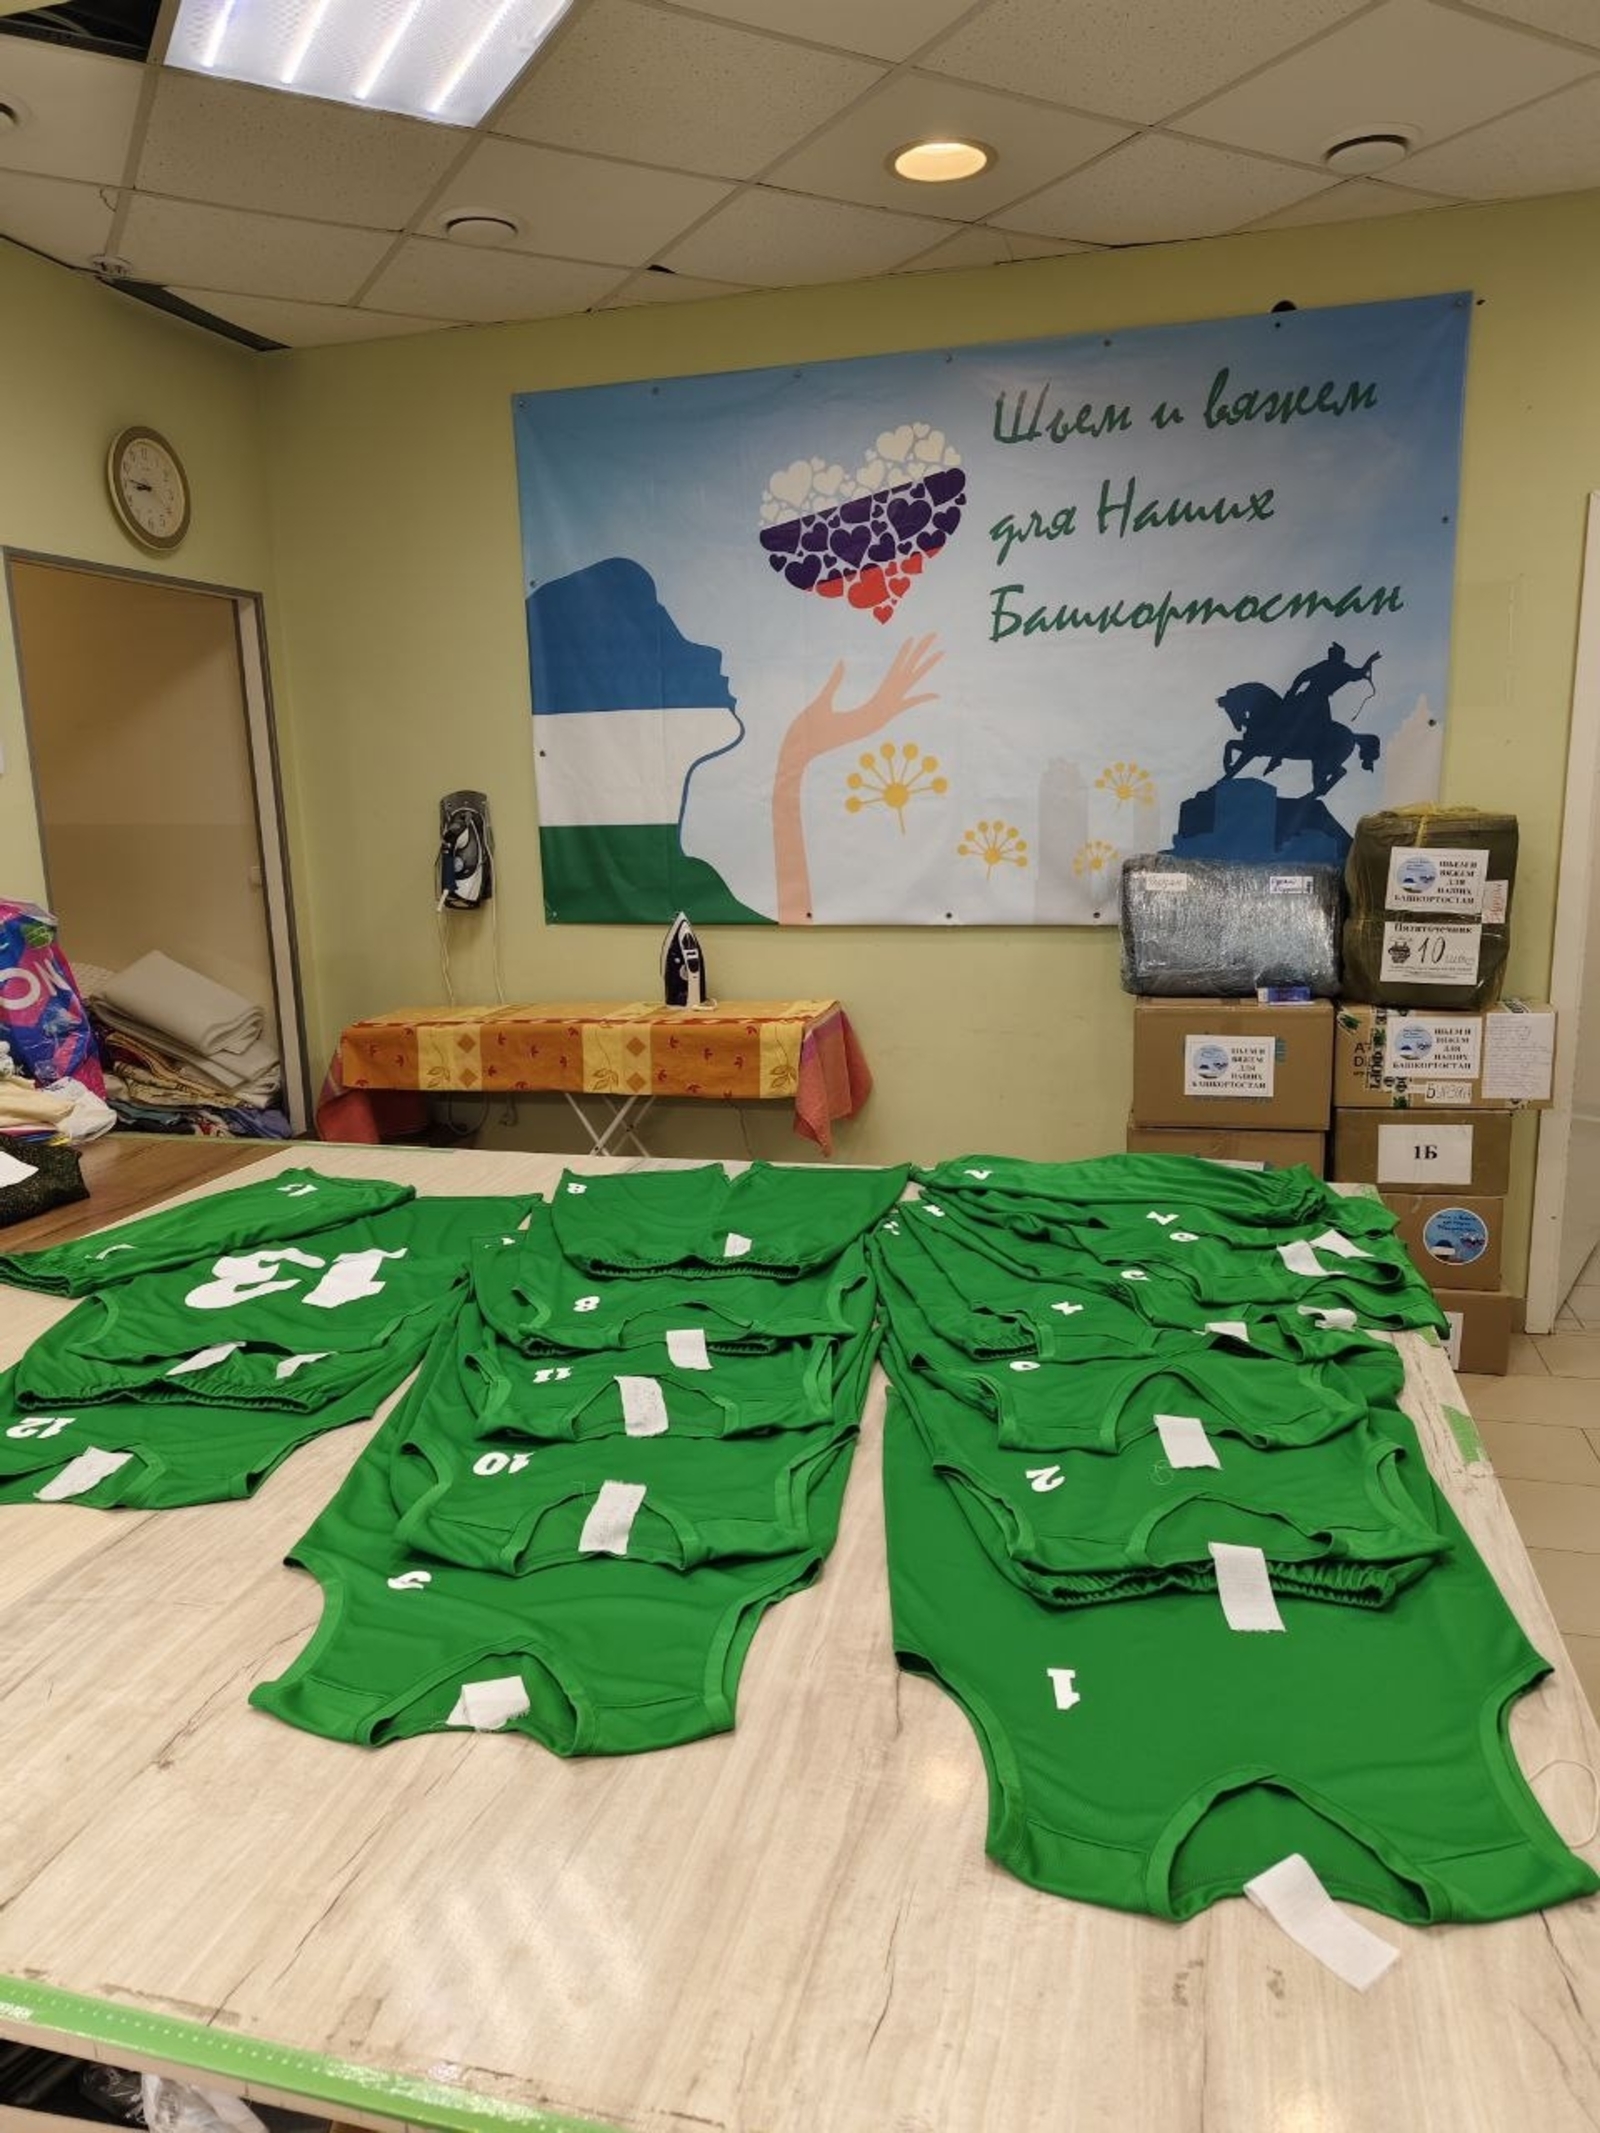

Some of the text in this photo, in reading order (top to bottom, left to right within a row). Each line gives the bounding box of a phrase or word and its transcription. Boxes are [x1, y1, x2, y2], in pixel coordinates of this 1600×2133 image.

[991, 367, 1378, 445] Шьем и вяжем
[989, 475, 1275, 566] для Наших
[988, 582, 1405, 648] Башкортостан
[1417, 936, 1447, 964] 10
[1413, 1144, 1438, 1160] 1Б
[566, 1182, 588, 1195] 8
[184, 1247, 409, 1309] 13
[572, 1295, 601, 1312] 8
[532, 1366, 573, 1384] 11
[5, 1417, 77, 1440] 12
[472, 1451, 536, 1476] 10
[1025, 1465, 1065, 1492] 2
[1046, 1667, 1081, 1710] 1
